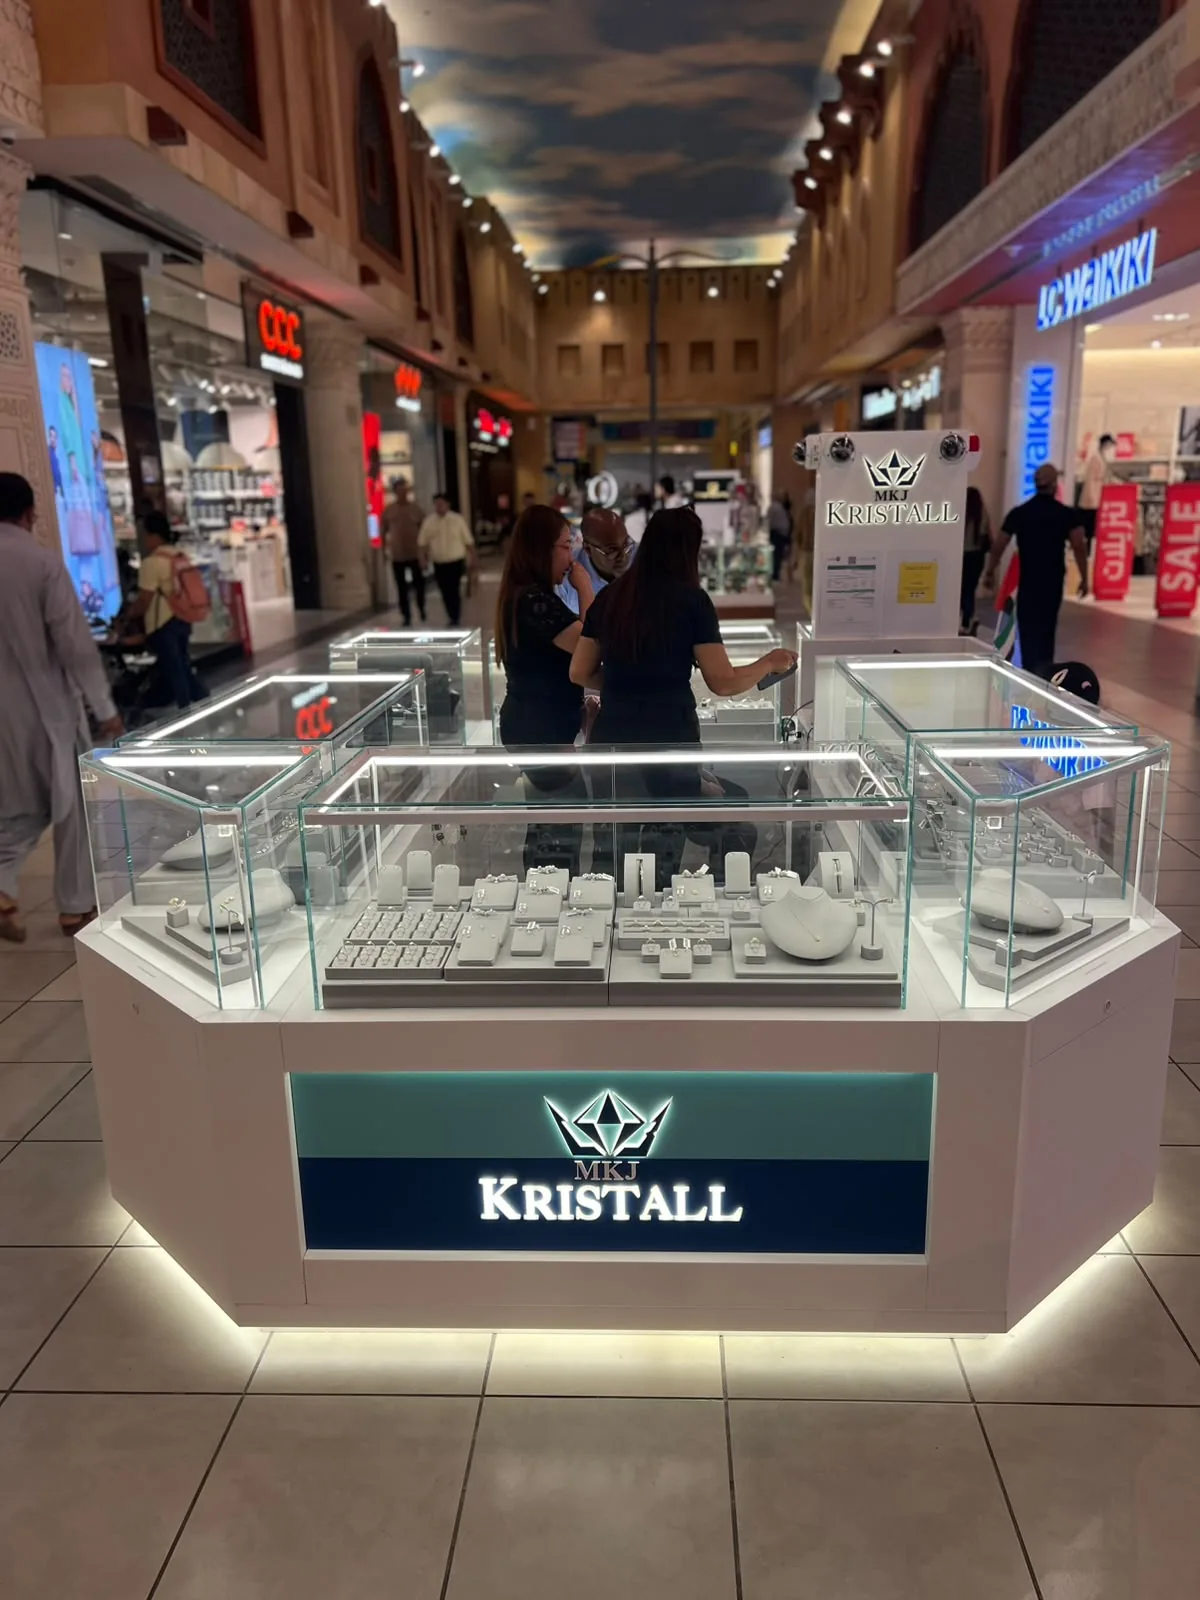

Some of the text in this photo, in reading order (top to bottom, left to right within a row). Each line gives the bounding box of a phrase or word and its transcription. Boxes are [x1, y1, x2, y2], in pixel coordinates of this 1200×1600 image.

[258, 299, 303, 361] CCC
[825, 500, 960, 526] KRISTALL
[874, 490, 909, 501] MKJ
[1160, 499, 1200, 592] SALE
[573, 1159, 641, 1182] MKJ
[477, 1176, 744, 1223] KRISTALL
